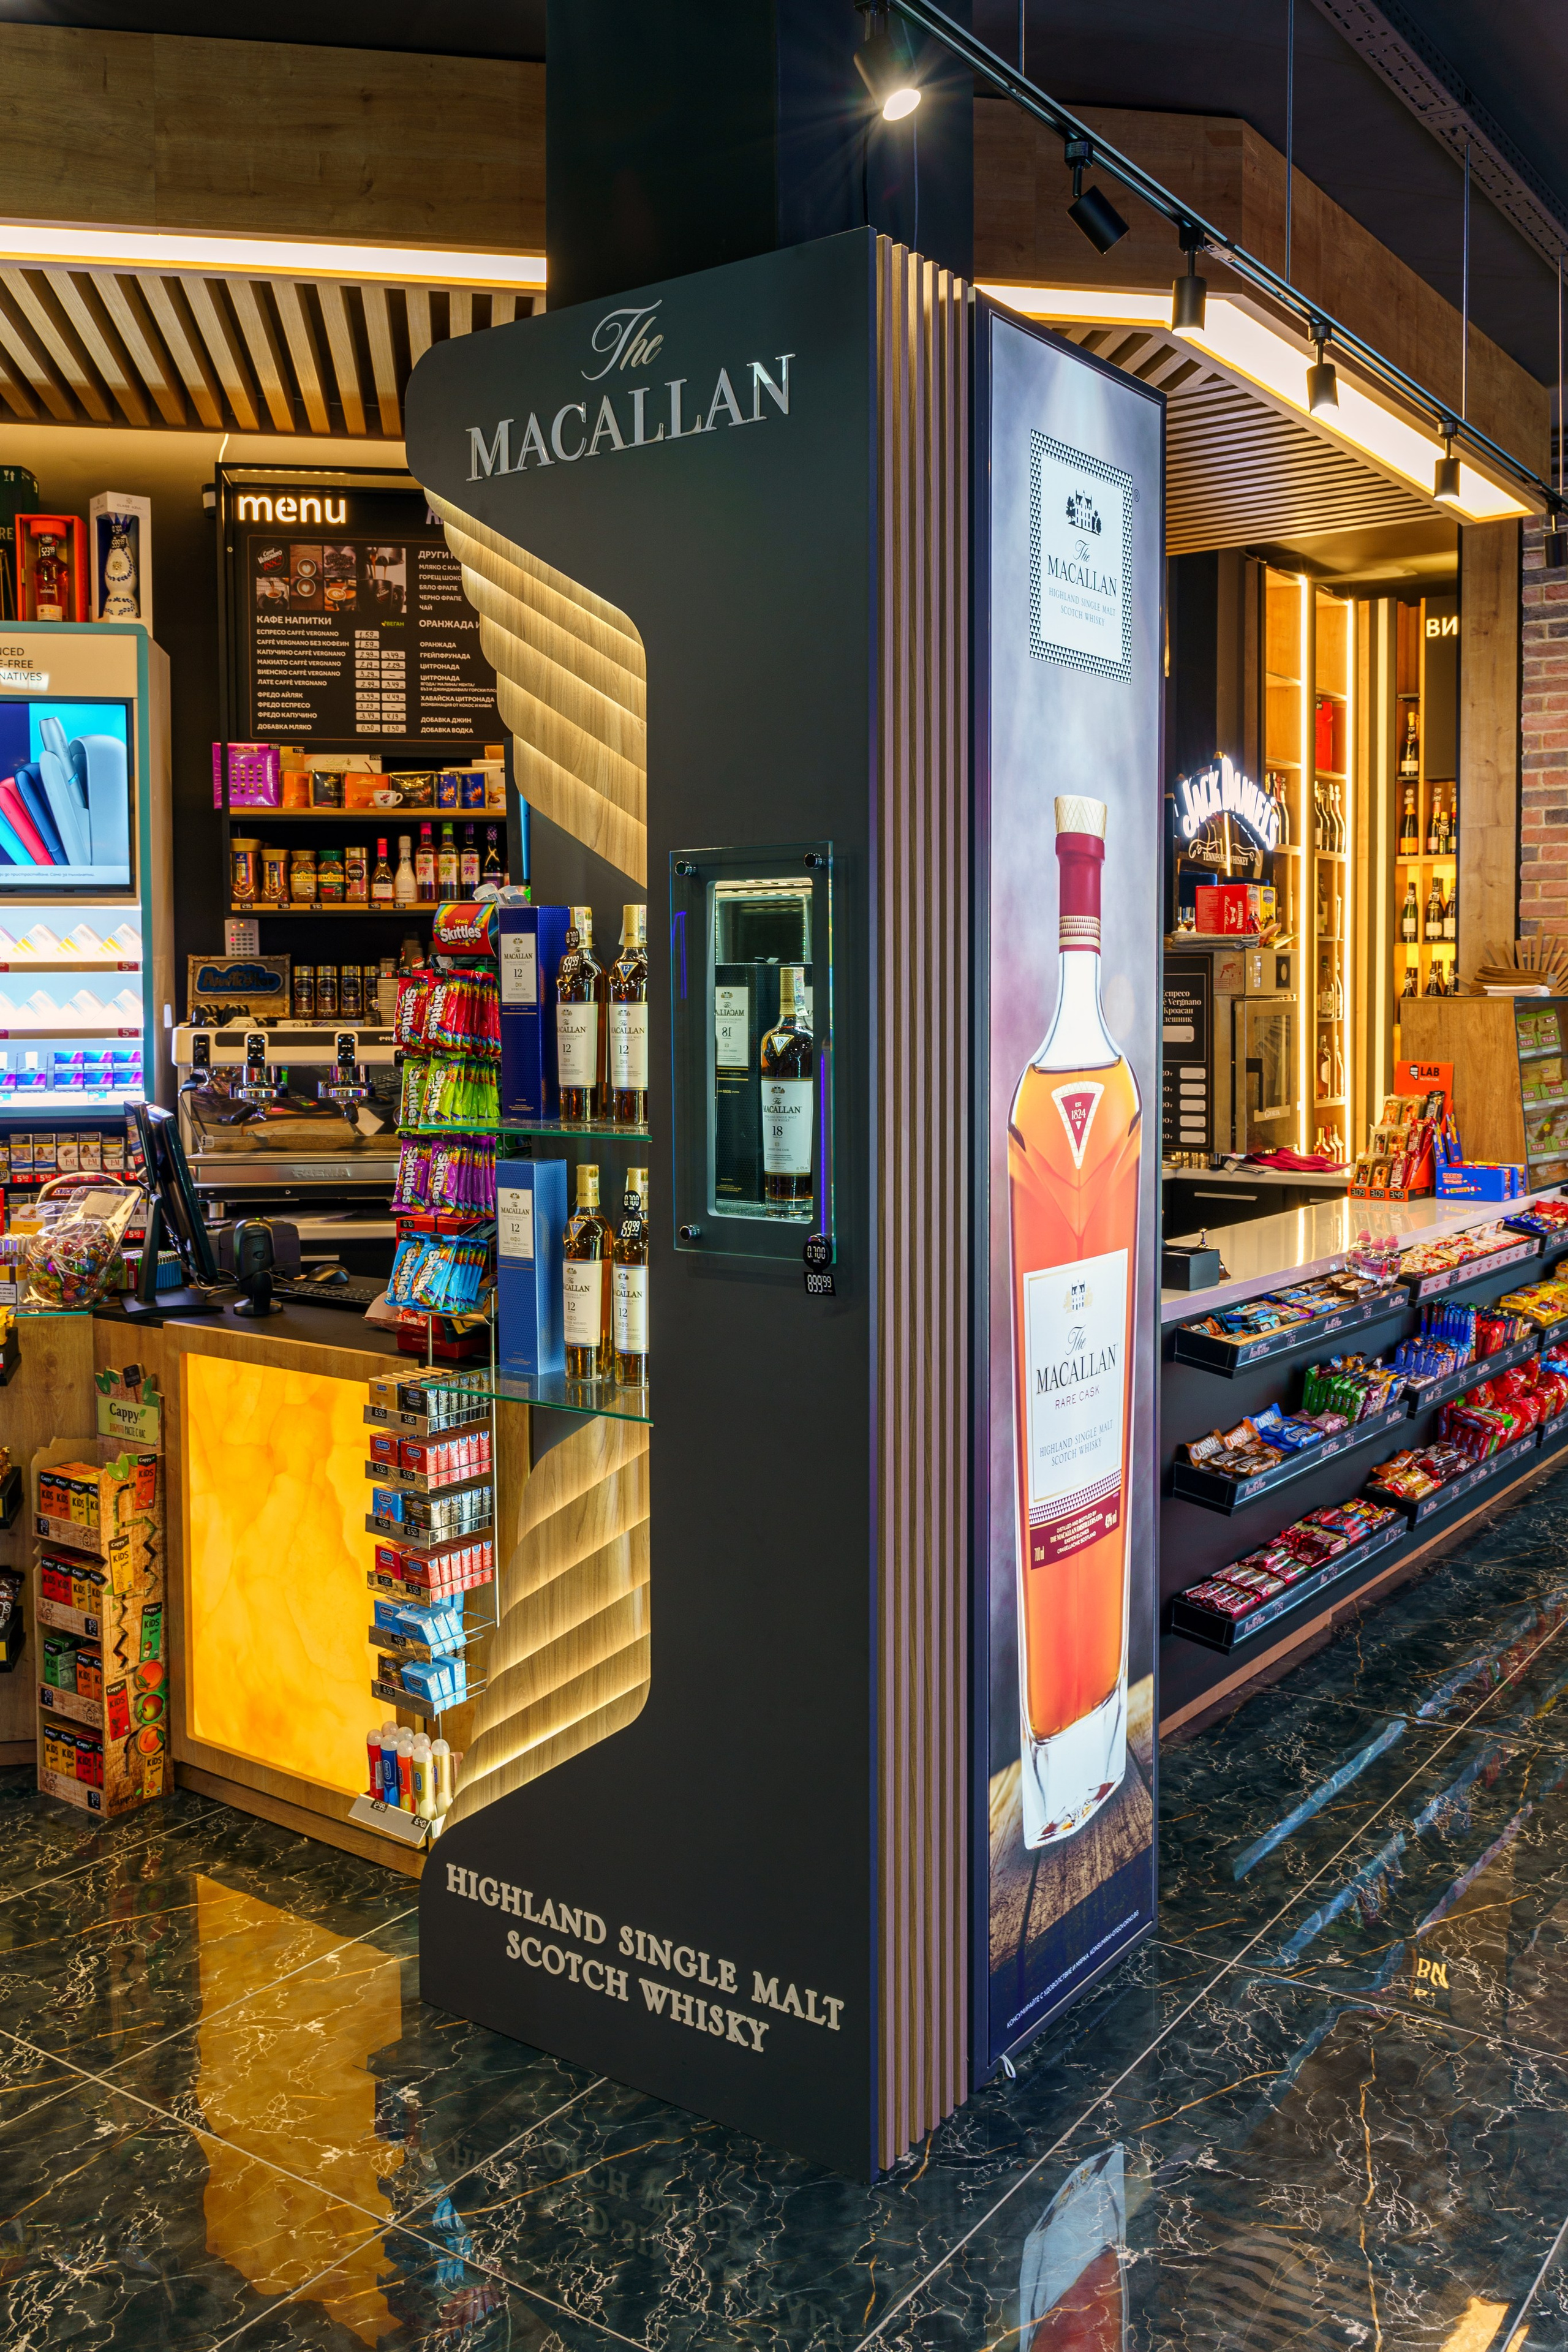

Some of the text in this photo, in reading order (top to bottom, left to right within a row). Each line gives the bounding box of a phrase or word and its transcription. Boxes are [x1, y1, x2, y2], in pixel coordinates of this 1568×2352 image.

[581, 300, 664, 380] The
[466, 353, 796, 481] MACALLAN
[238, 496, 346, 523] menu
[418, 551, 449, 559] ДРУГИ
[1072, 540, 1090, 563] The
[1047, 554, 1117, 597] MACALLAN
[1049, 587, 1115, 616] HIGHLAND SINGLE MALT
[257, 616, 331, 625] КАФЕ НАПИТКИ
[419, 620, 474, 630] ОРАНЖАДА
[1061, 605, 1105, 626] SCOTCH WHISKY
[1183, 771, 1222, 838] JACK
[440, 925, 481, 943] Skittles
[514, 968, 522, 978] 12
[428, 984, 447, 1040] Skittles
[1168, 998, 1202, 1007] Vergnano
[401, 988, 417, 1043] Skittles
[562, 1044, 571, 1053] 12
[619, 1045, 629, 1055] 12
[1420, 1066, 1440, 1077] LAB
[408, 1070, 420, 1126] Skittles
[772, 1097, 782, 1106] The
[1071, 1109, 1087, 1120] 1824
[772, 1126, 783, 1136] 18
[402, 1149, 418, 1204] Skittles
[432, 1152, 448, 1207] Skittles
[1351, 1188, 1404, 1199] 3.09 3.09 3.49
[511, 1223, 520, 1232] 12
[807, 1245, 826, 1259] 0.700
[396, 1247, 416, 1302] Skittles
[567, 1302, 576, 1311] 12
[619, 1308, 628, 1317] 12
[1065, 1326, 1087, 1355] The
[1036, 1344, 1117, 1395] MACALLAN
[1055, 1385, 1100, 1410] RARE CASK
[110, 1403, 140, 1424] Cappy
[377, 1441, 390, 1450] durex
[1040, 1419, 1113, 1457] HIGHLAND SINGLE MALT
[1193, 1436, 1216, 1460] CORNY
[1224, 1425, 1248, 1450] CORNY
[1052, 1437, 1102, 1466] SCOTCH WHISKY
[379, 1519, 389, 1528] 4.50
[381, 1551, 393, 1561] durex
[446, 1863, 845, 2030] HIGHLAND SINGLE MALT
[506, 1930, 769, 2052] SCOTCH WHISKY
